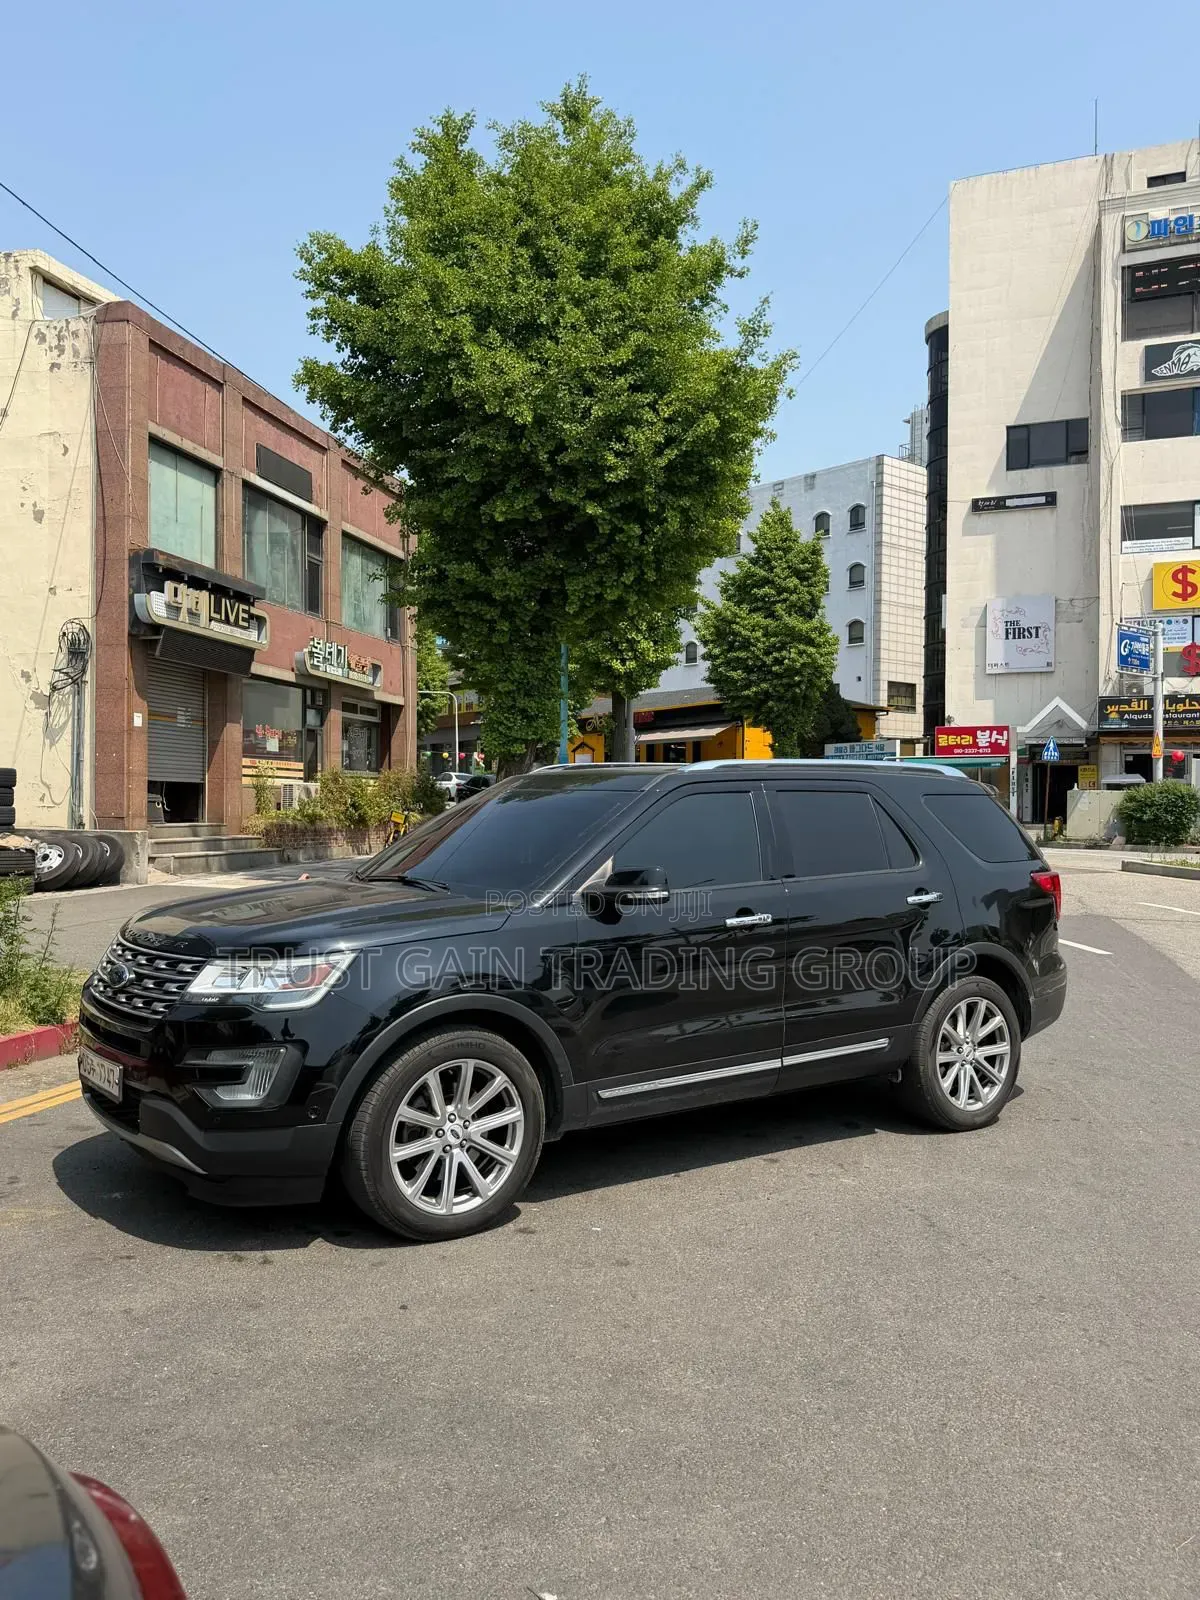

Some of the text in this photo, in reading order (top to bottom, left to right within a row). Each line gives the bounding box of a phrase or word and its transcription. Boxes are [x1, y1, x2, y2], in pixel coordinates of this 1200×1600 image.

[1149, 214, 1200, 239] 파인
[210, 593, 249, 627] LIVE
[1004, 626, 1041, 640] FIRST
[1162, 711, 1200, 719] estaurant
[937, 729, 1008, 747] 로터리 분식
